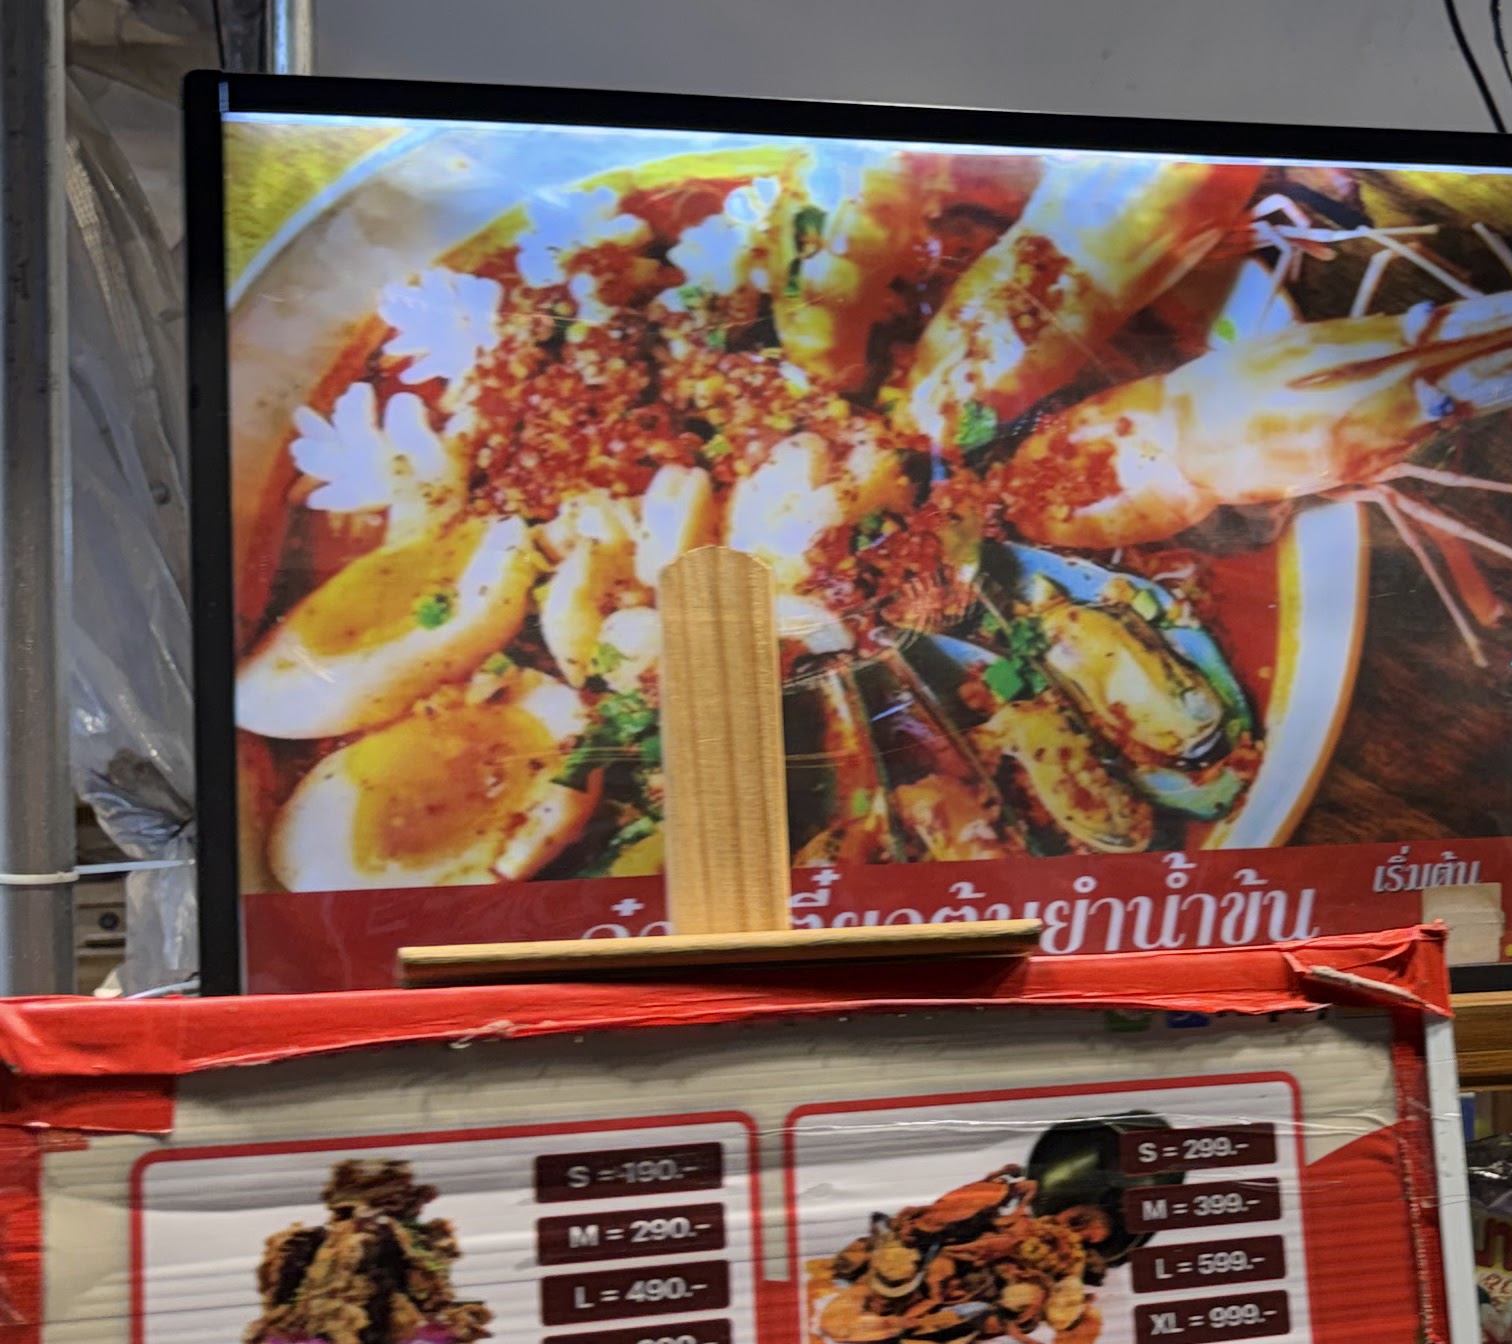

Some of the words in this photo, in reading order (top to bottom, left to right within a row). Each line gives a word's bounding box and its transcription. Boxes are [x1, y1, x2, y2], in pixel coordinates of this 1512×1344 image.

[1138, 1142, 1158, 1163] S
[1142, 1199, 1168, 1221] M
[568, 1224, 600, 1248] M
[1155, 1258, 1174, 1280] L
[574, 1286, 595, 1309] L
[1149, 1312, 1185, 1335] XL
